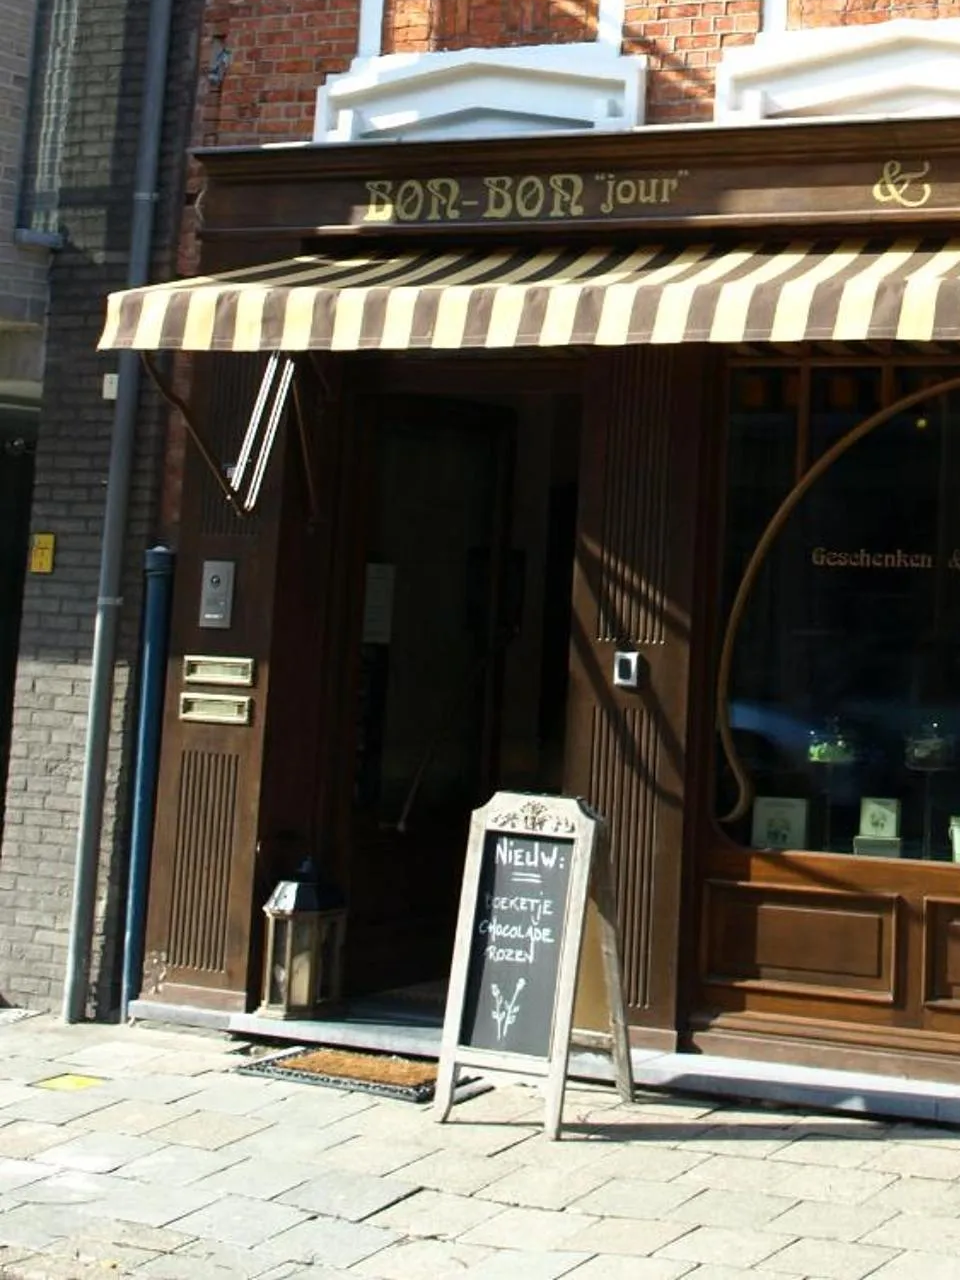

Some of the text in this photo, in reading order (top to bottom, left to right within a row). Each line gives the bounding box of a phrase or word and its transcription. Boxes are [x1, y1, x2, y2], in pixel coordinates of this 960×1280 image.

[364, 172, 585, 222] BON-BON
[872, 160, 932, 208] &
[811, 546, 933, 570] Geschenken
